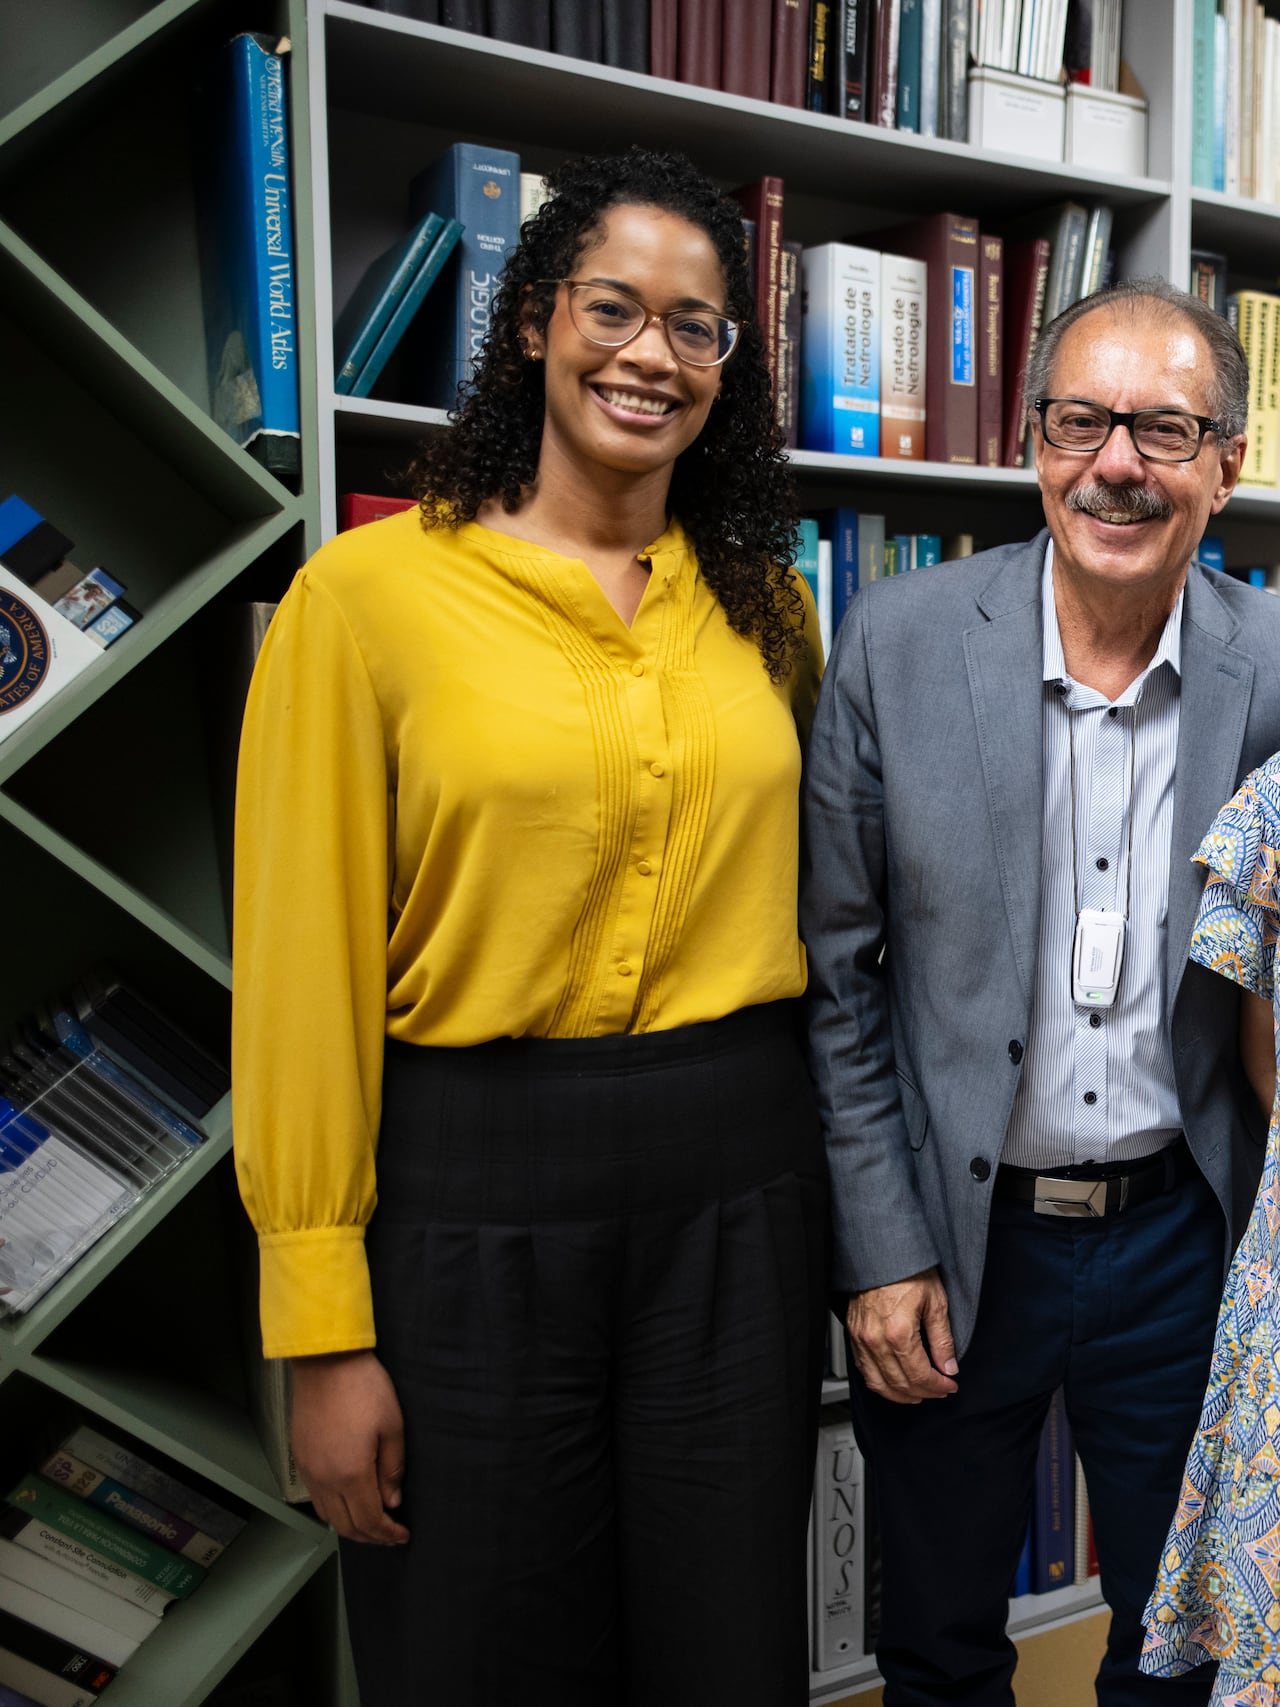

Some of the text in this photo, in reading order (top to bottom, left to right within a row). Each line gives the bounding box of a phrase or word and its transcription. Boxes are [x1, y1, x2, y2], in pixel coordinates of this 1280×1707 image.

[845, 8, 857, 55] PATIENT
[267, 76, 282, 113] Rand
[473, 163, 511, 176] LIPPINCOTT
[477, 234, 505, 245] EDITION
[480, 243, 502, 252] THIRD
[264, 173, 293, 370] Universal World Atlas
[988, 273, 999, 302] Renal
[843, 287, 857, 386] Tratado de
[892, 298, 905, 394] Tratado de
[986, 303, 999, 376] Transplantation
[9, 602, 44, 660] AMERICA
[96, 619, 118, 636] SP
[26, 662, 41, 682] OF
[54, 1461, 75, 1481] SP
[105, 1491, 178, 1540] Panasonic
[826, 1446, 860, 1596] UNOS
[39, 1530, 86, 1558] Constant-Site
[86, 1553, 128, 1580] Cannulation
